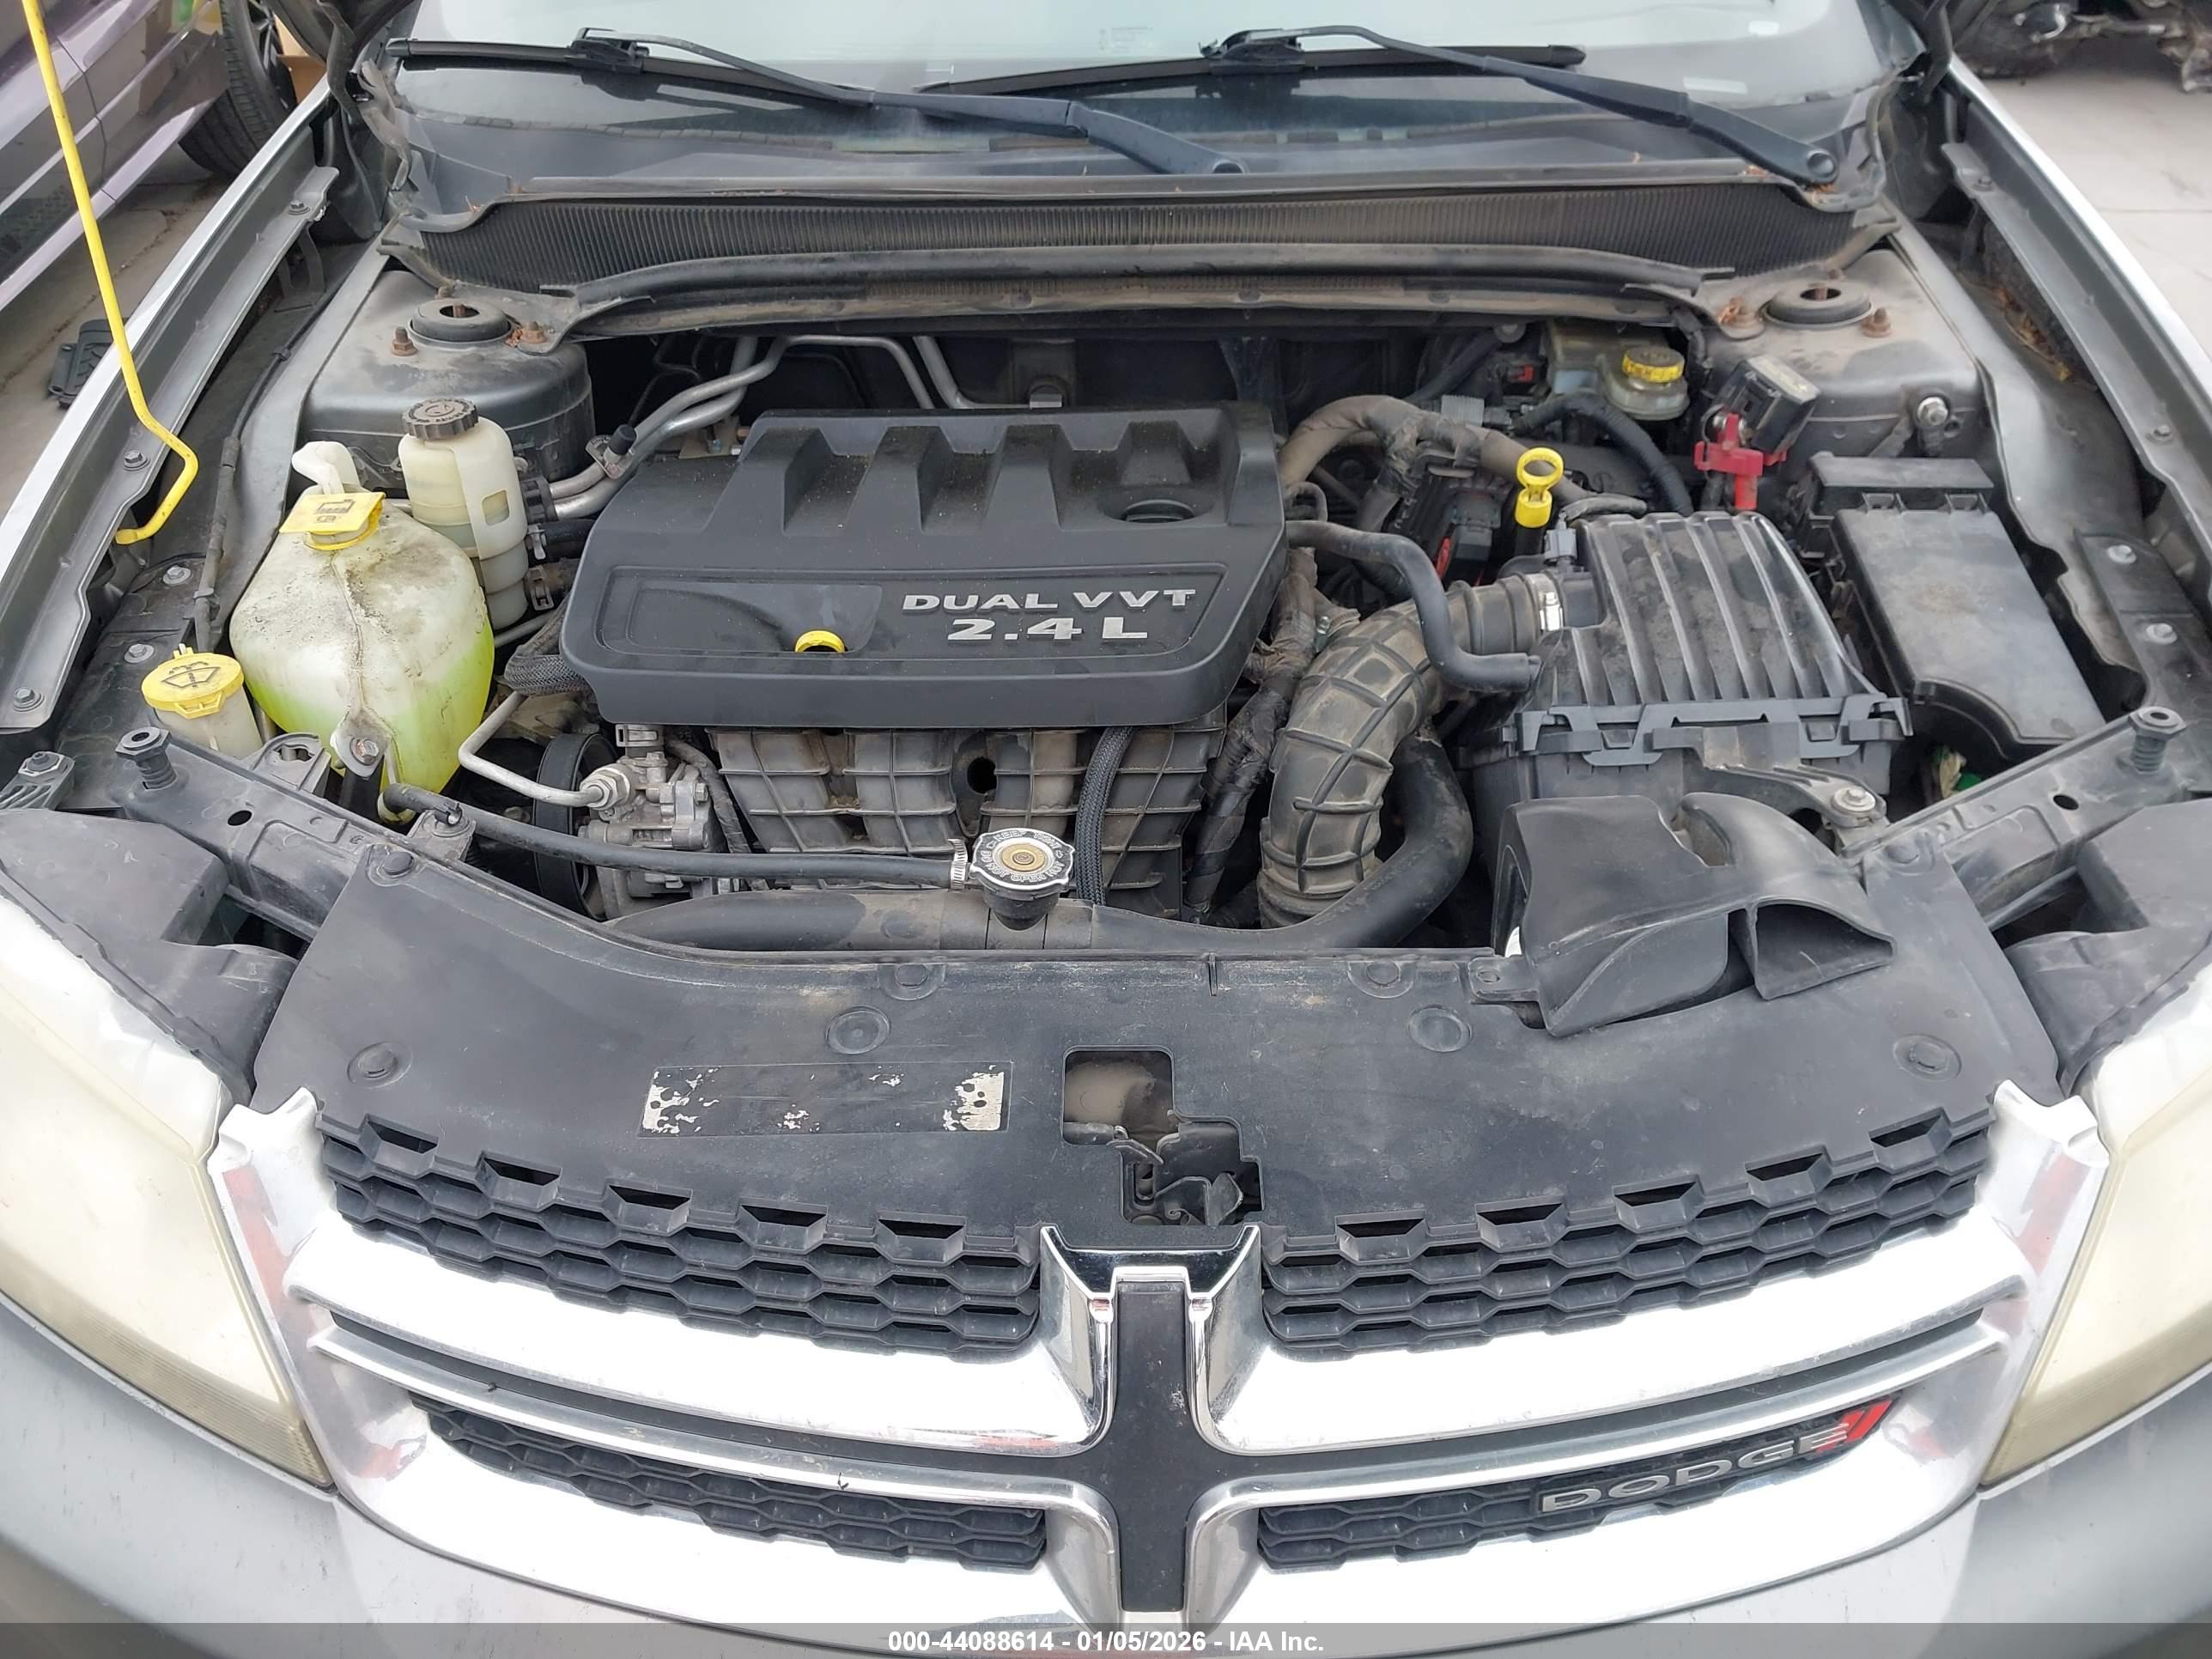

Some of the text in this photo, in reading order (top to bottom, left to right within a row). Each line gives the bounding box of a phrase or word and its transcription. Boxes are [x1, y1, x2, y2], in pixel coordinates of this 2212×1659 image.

[902, 588, 1196, 611] DUAL VVT
[994, 830, 1063, 848] KEEP TIGHT
[981, 850, 1066, 882] DO NOT OPEN HOT
[1541, 1422, 1850, 1513] DODGE
